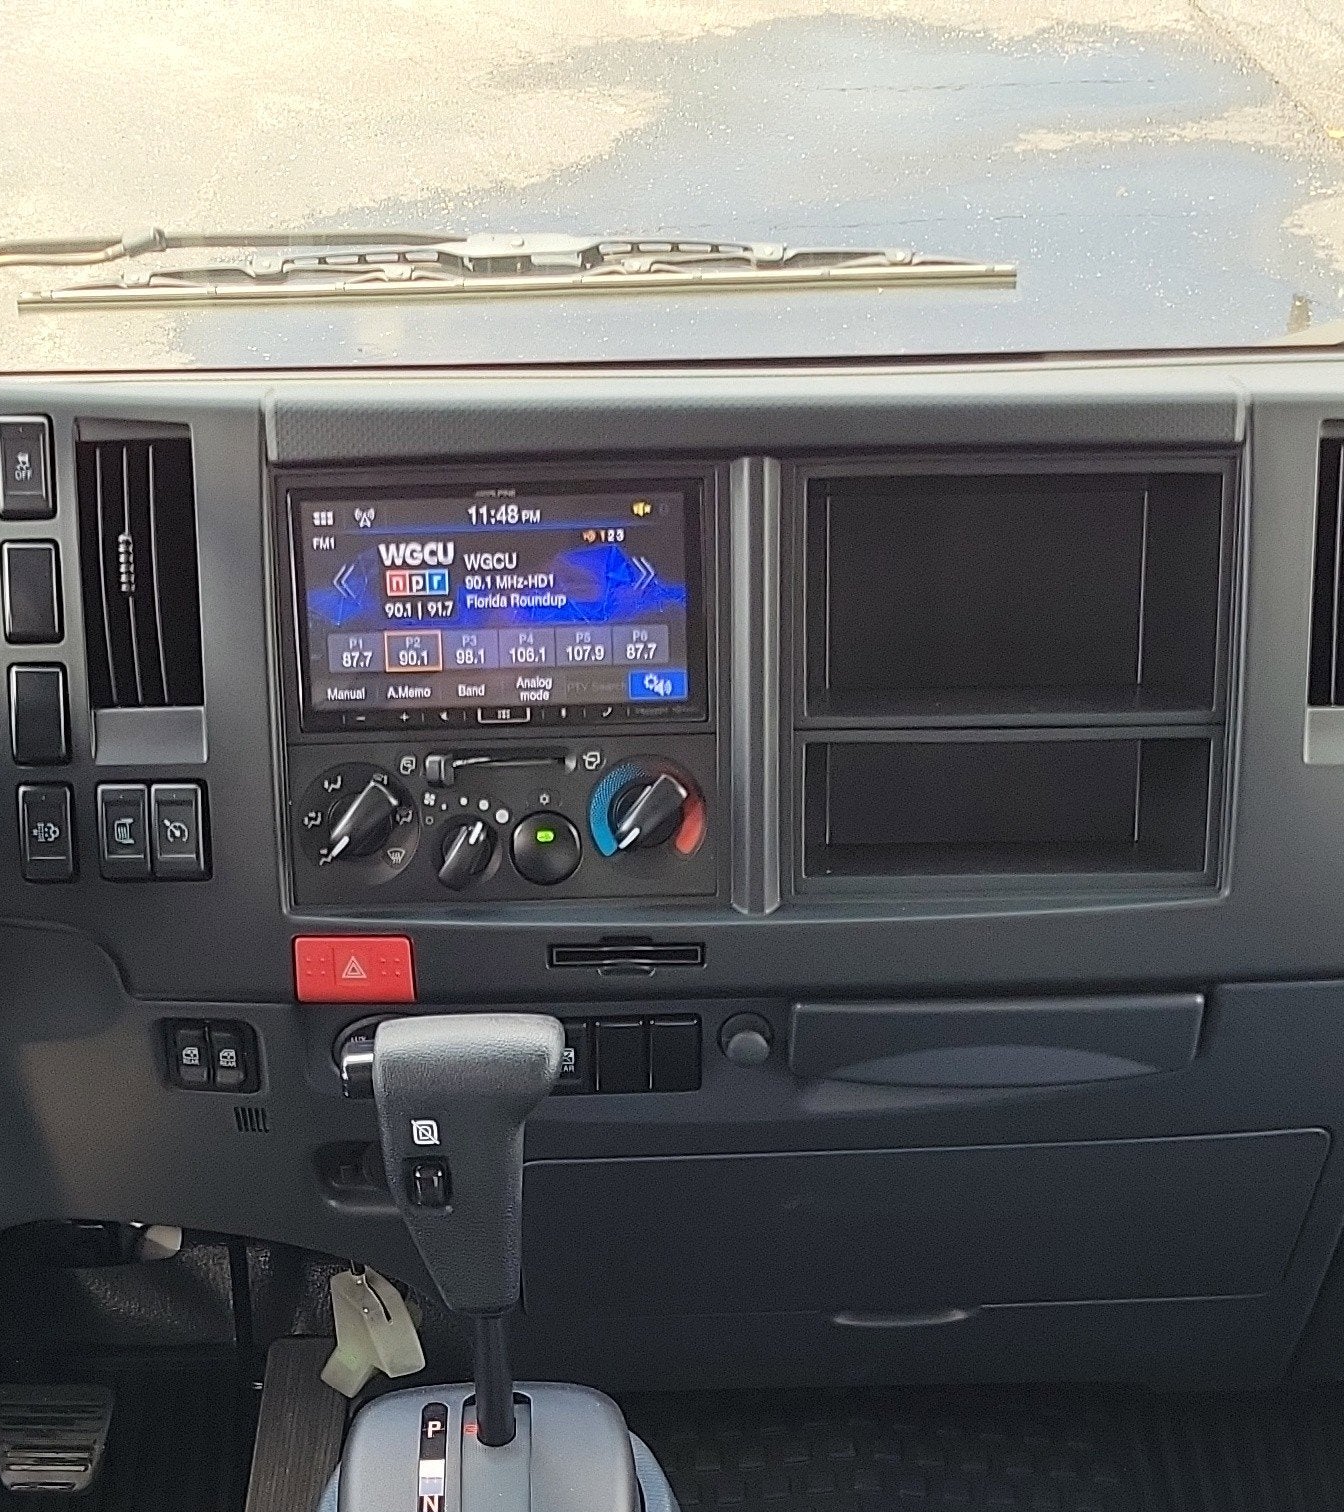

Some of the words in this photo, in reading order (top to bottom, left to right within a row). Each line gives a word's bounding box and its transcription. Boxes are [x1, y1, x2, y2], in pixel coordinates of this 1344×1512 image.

[15, 470, 32, 480] OFF
[468, 505, 519, 525] 11:48
[522, 509, 541, 523] PM
[313, 538, 335, 550] FM1
[378, 542, 454, 567] WGCU
[464, 553, 517, 572] WGCU
[390, 573, 444, 594] npr
[465, 576, 491, 590] 90.1
[496, 574, 555, 589] MHz-HD1
[466, 594, 507, 609] Florida
[510, 593, 567, 609] Roundup
[385, 602, 411, 619] 90.1
[427, 601, 453, 617] 91.7
[349, 638, 363, 649] P1
[406, 637, 421, 648] P2
[462, 635, 477, 647] P3
[519, 633, 534, 645] P4
[399, 651, 428, 666] 90.1
[456, 649, 485, 664] 98.1
[566, 645, 605, 662] 107.9
[626, 643, 657, 660] 87.7
[342, 651, 373, 668] 87.7
[458, 684, 485, 697] Band
[516, 676, 553, 691] Analog
[327, 687, 366, 700] Manual
[387, 686, 432, 699] A.Memo
[520, 690, 550, 701] mode
[427, 1420, 441, 1438] P
